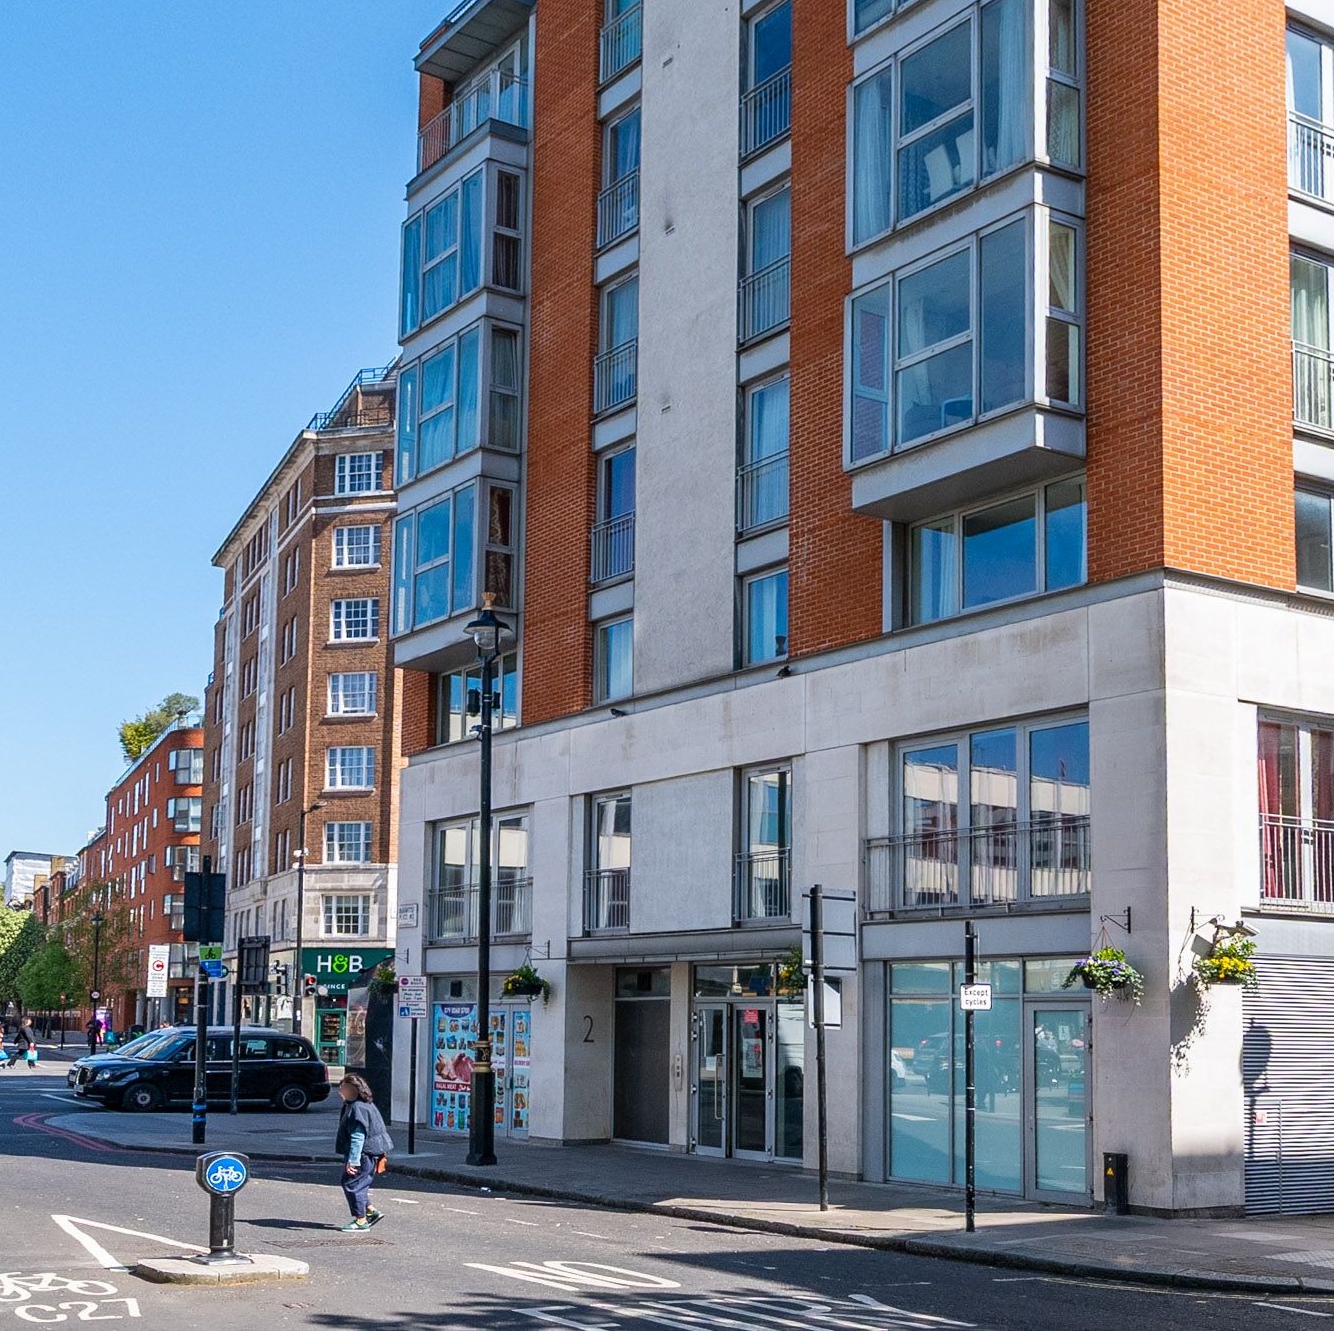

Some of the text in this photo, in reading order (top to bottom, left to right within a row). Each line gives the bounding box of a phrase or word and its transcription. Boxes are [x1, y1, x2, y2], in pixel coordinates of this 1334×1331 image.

[316, 953, 364, 973] H&B
[964, 987, 988, 997] Except
[965, 999, 987, 1007] cycles
[583, 1015, 595, 1043] 2
[462, 1260, 682, 1291] NO
[14, 1297, 143, 1323] C27
